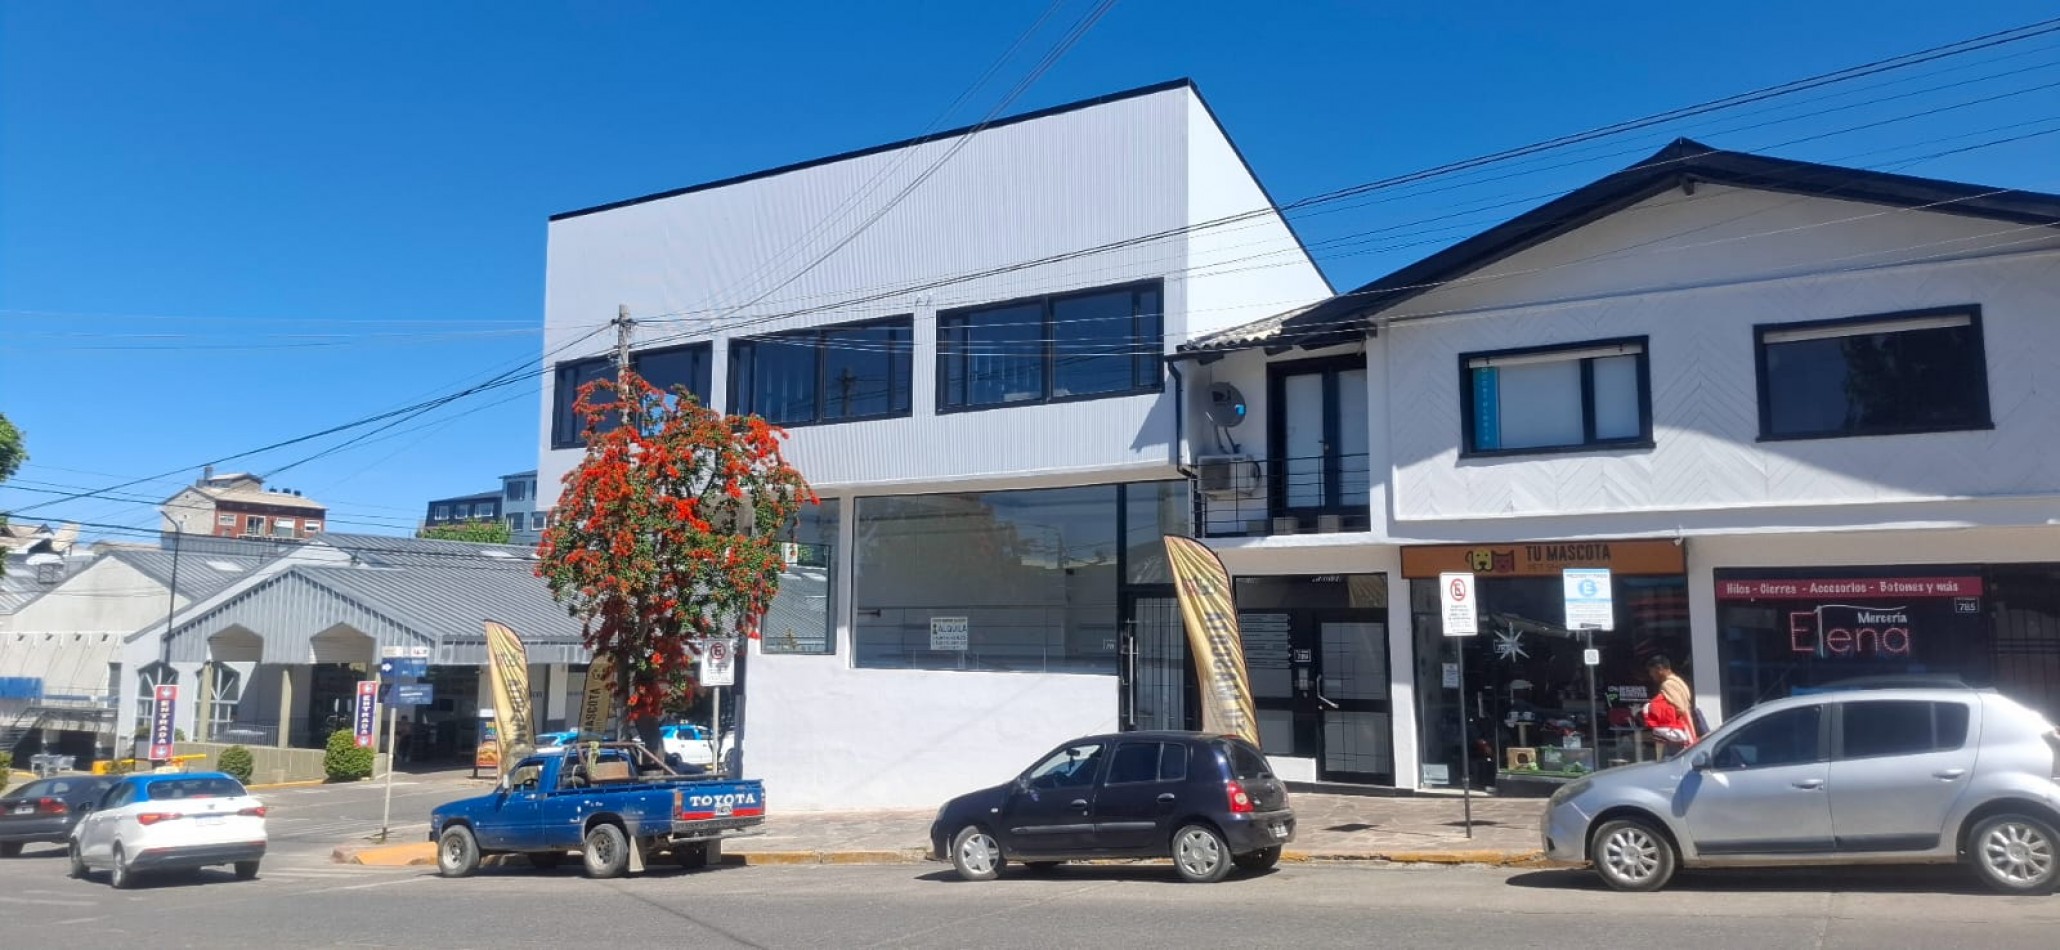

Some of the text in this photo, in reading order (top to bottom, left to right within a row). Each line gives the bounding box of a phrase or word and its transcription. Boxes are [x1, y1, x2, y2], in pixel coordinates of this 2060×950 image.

[1526, 544, 1611, 561] TU MASCOTA
[157, 700, 170, 744] ENTRADA
[361, 694, 371, 735] ENTRADA
[689, 793, 756, 808] TOYOTA
